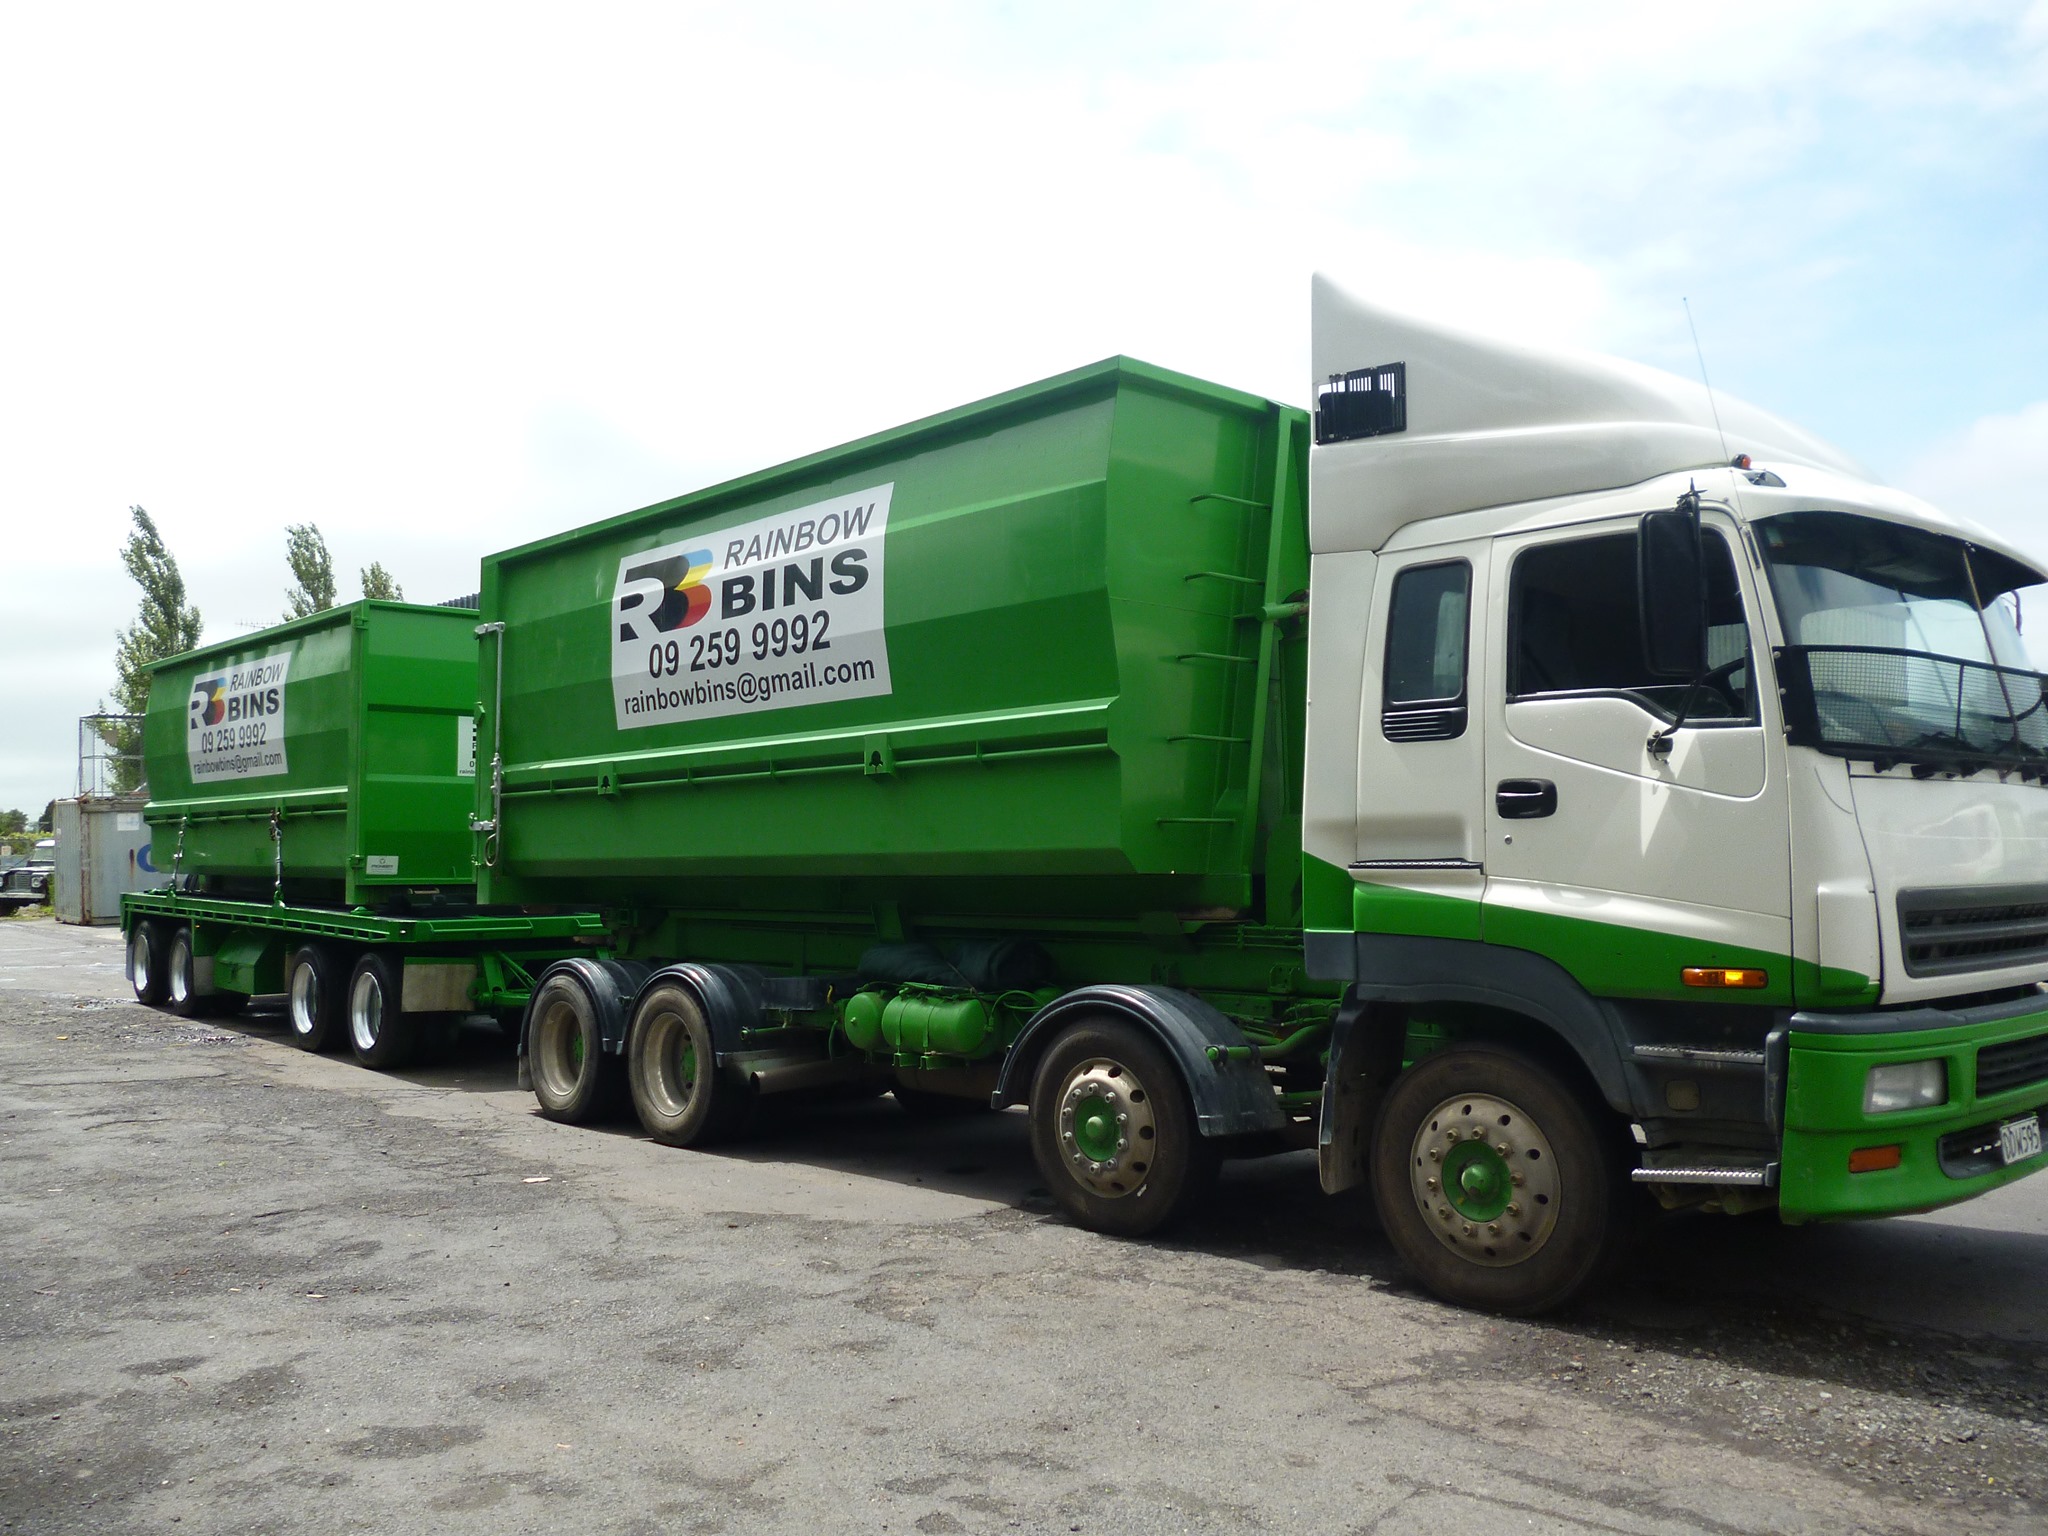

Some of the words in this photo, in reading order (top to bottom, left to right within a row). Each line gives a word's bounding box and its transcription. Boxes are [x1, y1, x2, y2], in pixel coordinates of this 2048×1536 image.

[724, 503, 875, 570] RAINBOW
[721, 548, 869, 620] BINS
[649, 640, 679, 678] 09
[690, 628, 740, 672] 259
[752, 610, 831, 661] 9992
[230, 662, 284, 692] RAINBOW
[624, 658, 875, 715] rainbowbins@gmail.com
[228, 688, 280, 722] BINS
[202, 731, 214, 754] 09
[217, 727, 235, 752] 259
[239, 722, 266, 748] 9992
[193, 752, 283, 775] rainbowbins@gmail.com
